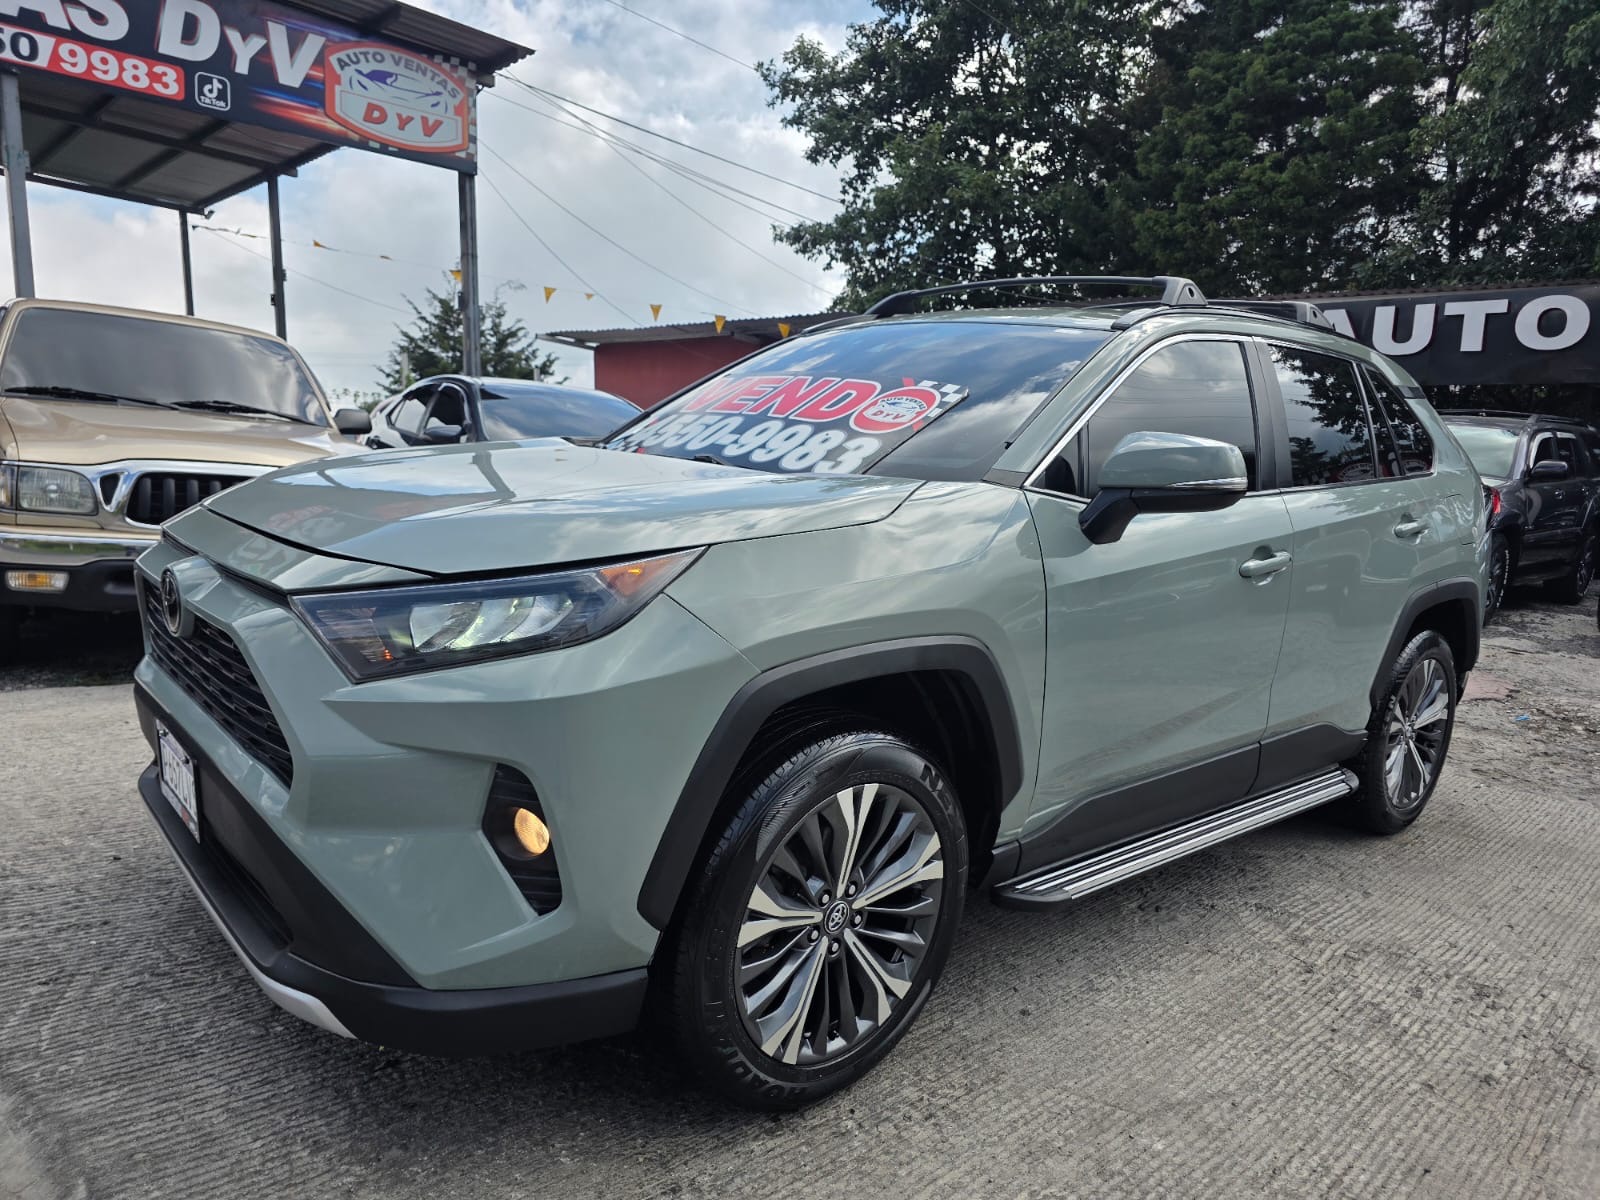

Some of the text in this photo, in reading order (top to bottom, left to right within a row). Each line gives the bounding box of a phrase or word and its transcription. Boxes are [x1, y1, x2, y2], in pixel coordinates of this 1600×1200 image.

[0, 28, 179, 96] 0 9983
[336, 51, 461, 99] AUTO VENTAS
[199, 95, 227, 109] TikTok
[363, 102, 444, 138] DYV
[680, 375, 942, 433] VENDO
